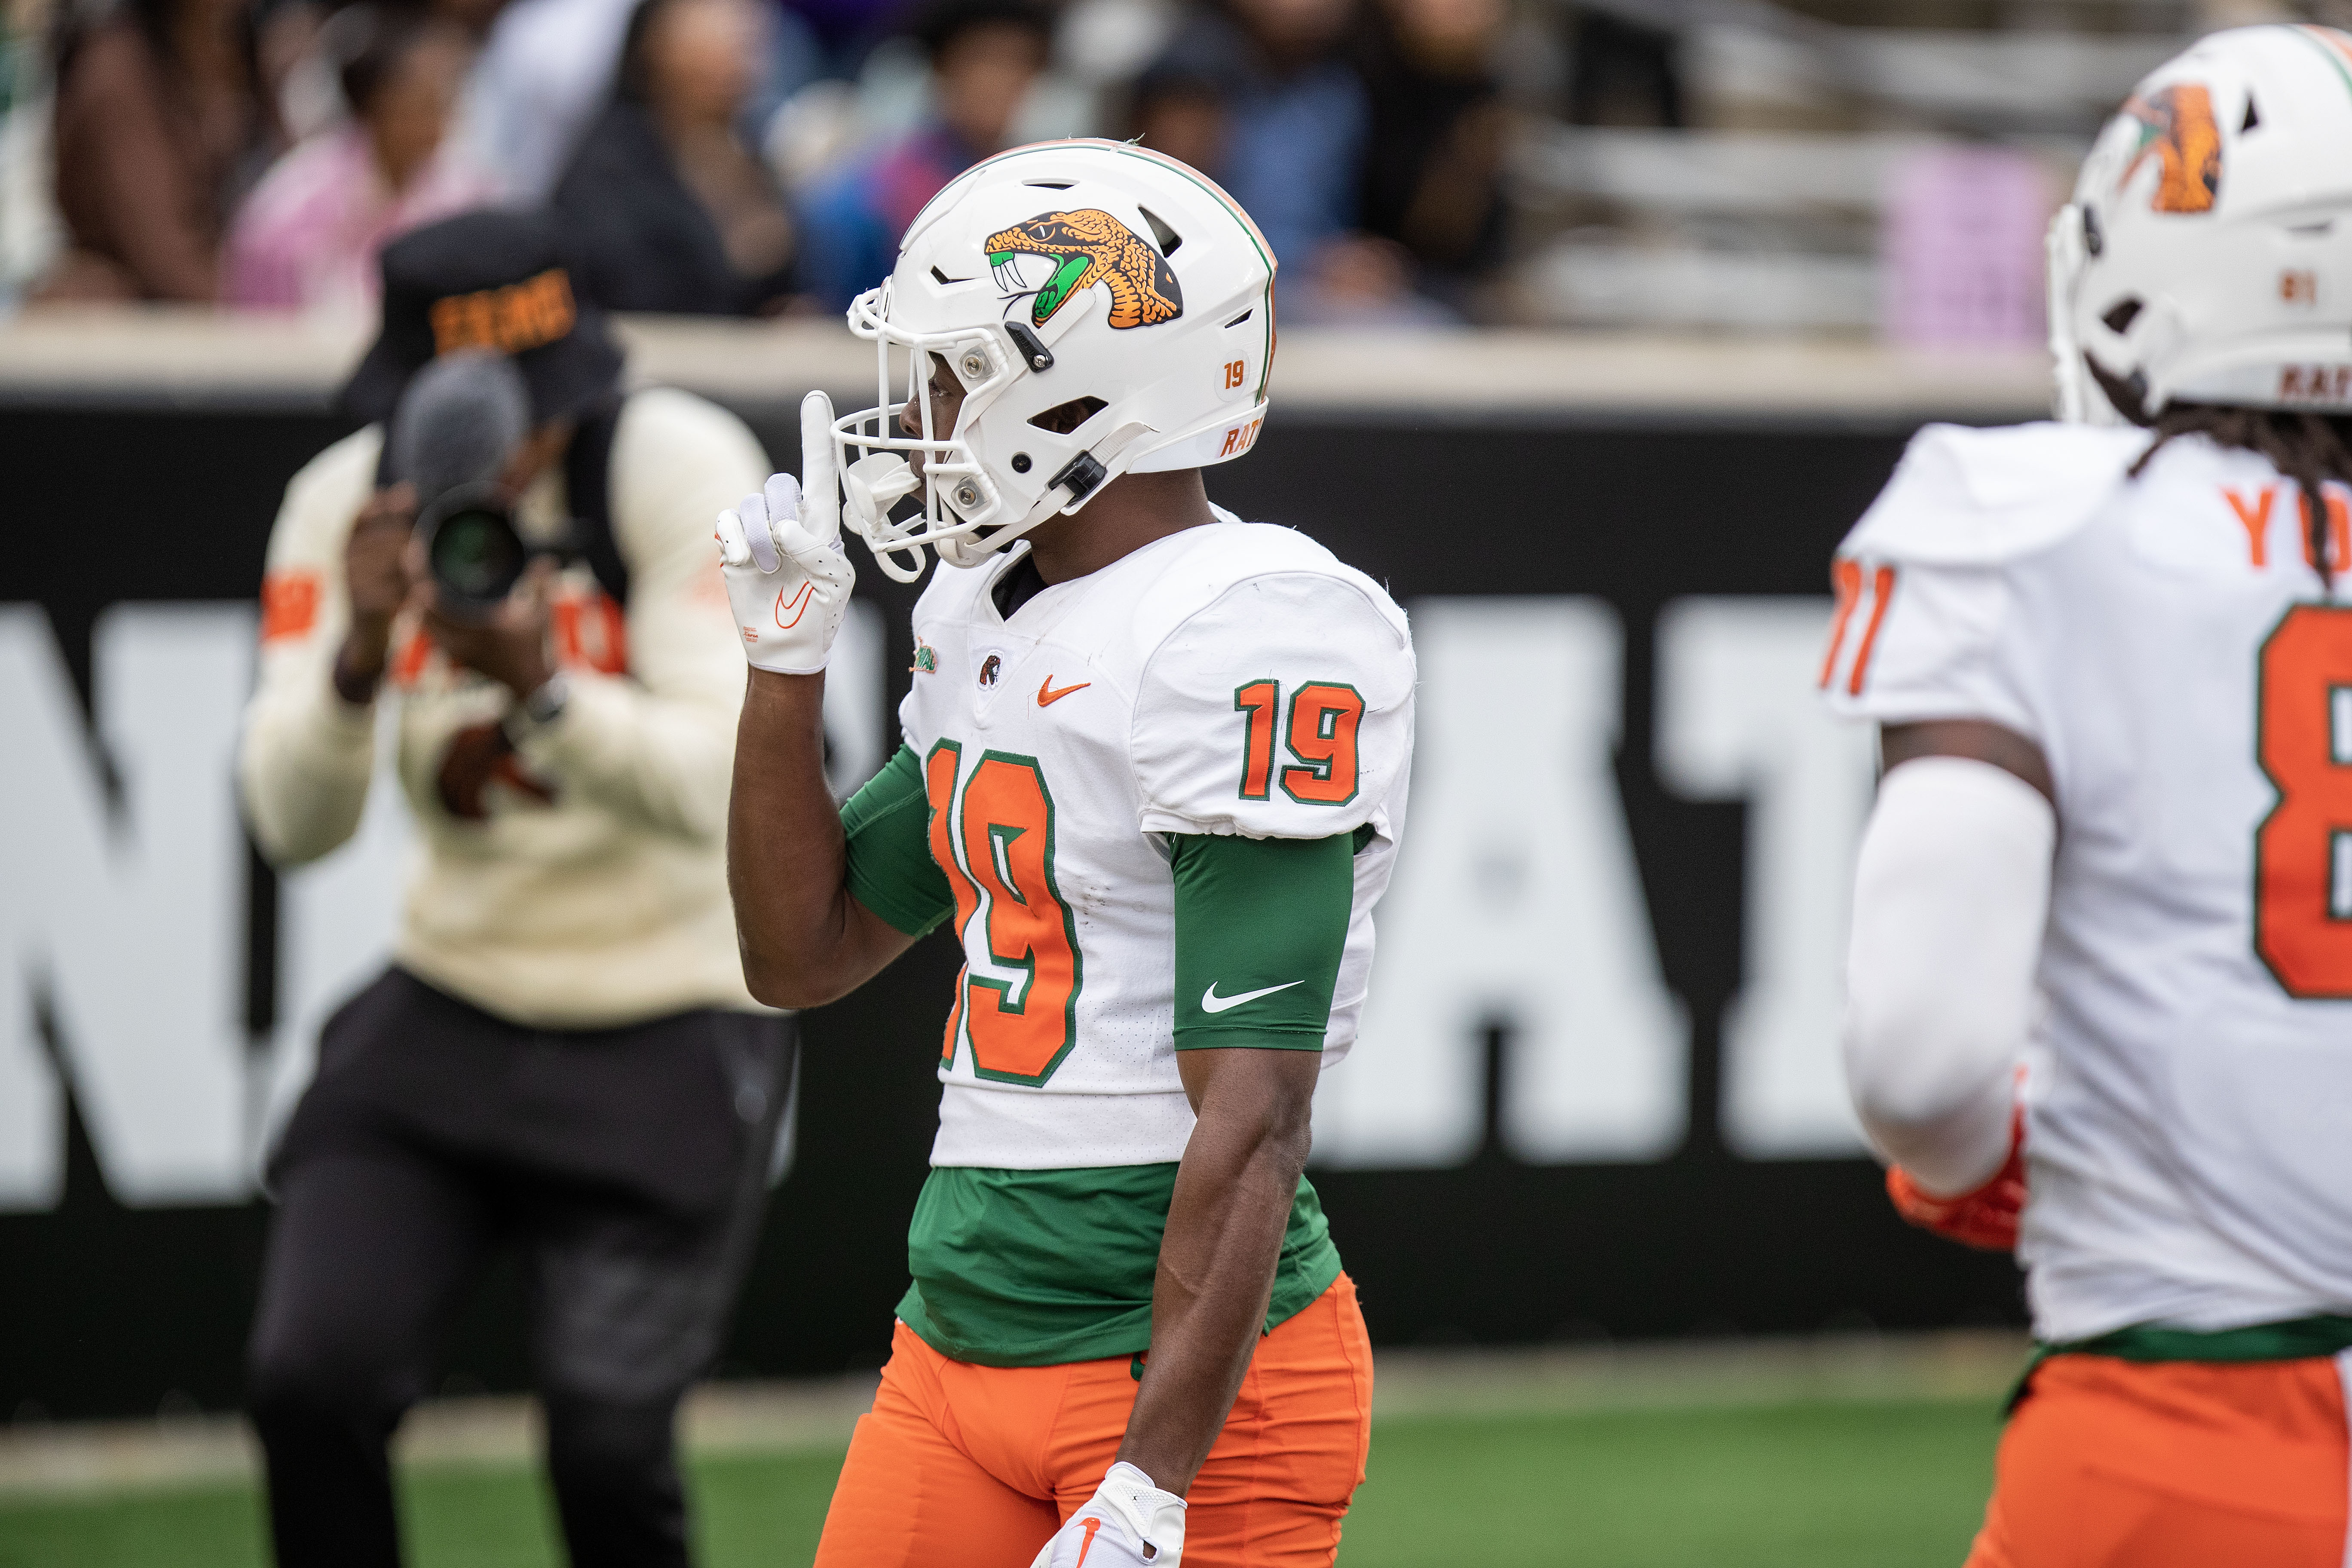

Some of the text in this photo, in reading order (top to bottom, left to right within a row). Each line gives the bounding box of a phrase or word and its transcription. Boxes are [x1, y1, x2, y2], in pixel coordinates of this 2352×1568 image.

[1224, 360, 1244, 389] 19
[1220, 413, 1265, 457] RAT
[1234, 678, 1366, 807] 19
[926, 736, 1084, 1088] 19
